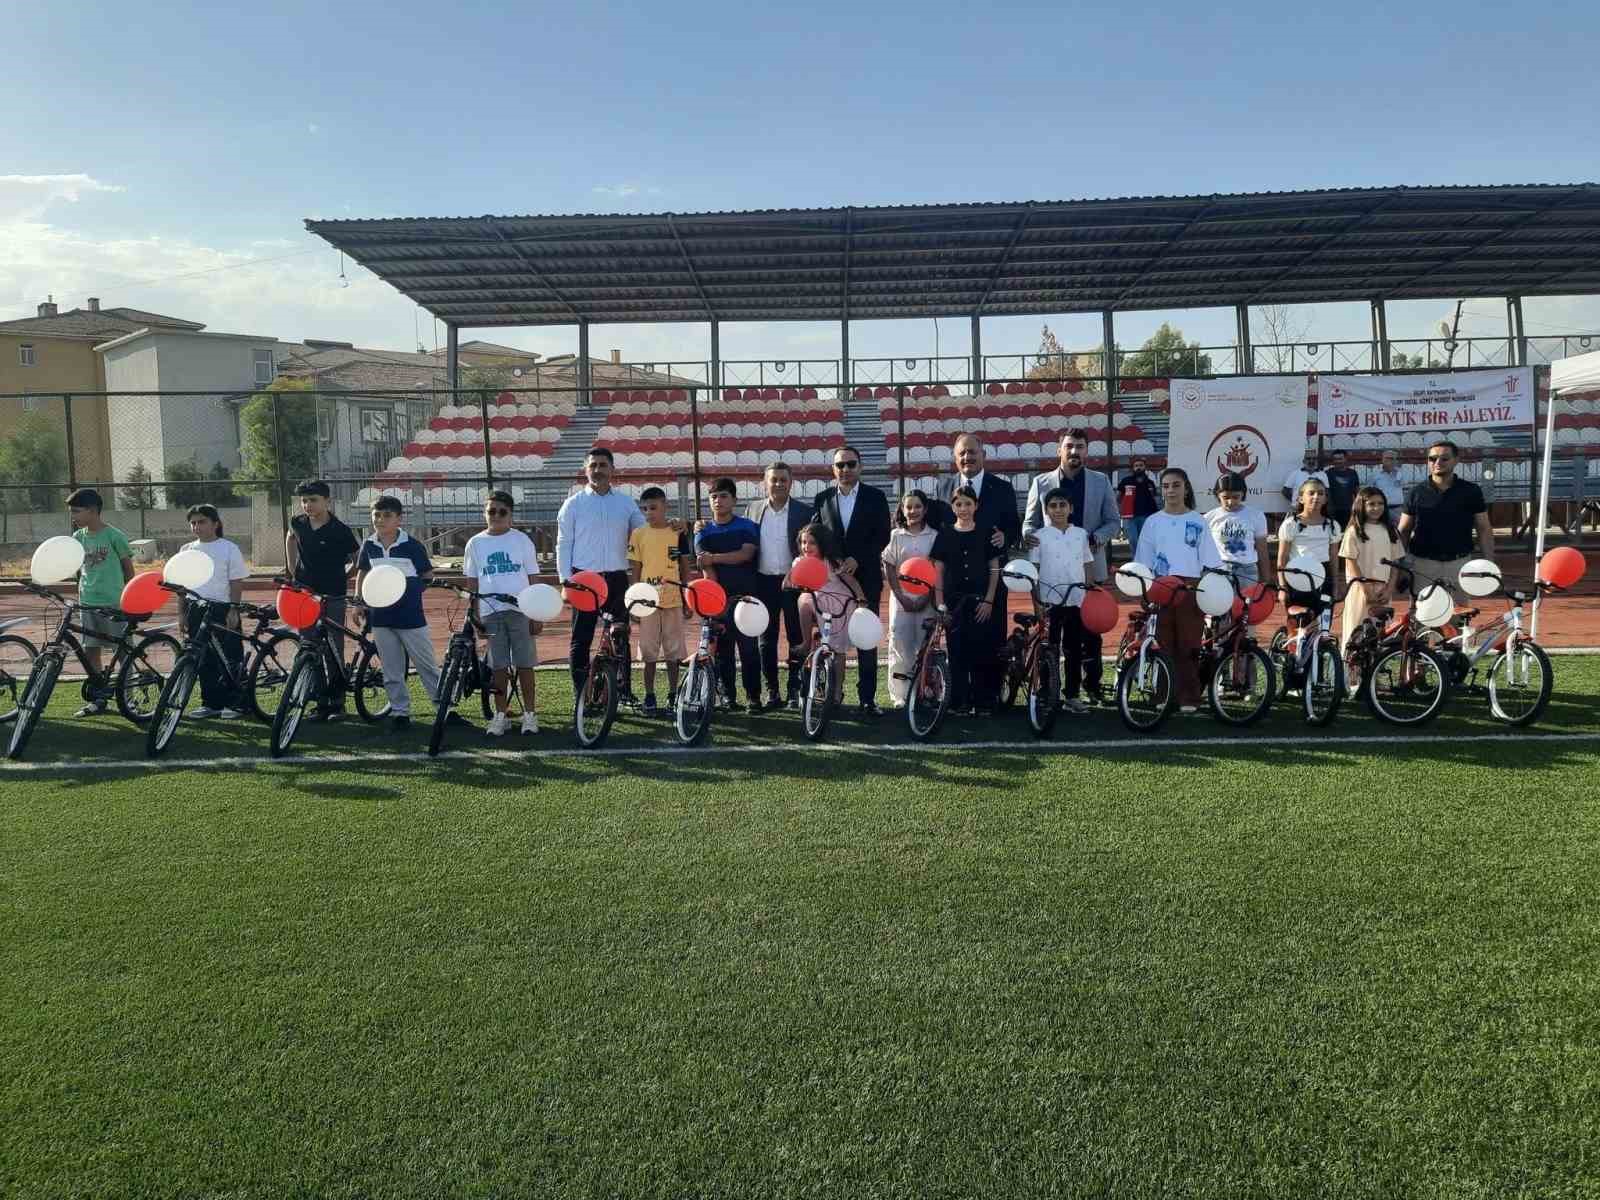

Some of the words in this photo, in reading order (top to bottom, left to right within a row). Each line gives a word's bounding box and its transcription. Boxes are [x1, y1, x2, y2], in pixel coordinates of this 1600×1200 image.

[1334, 409, 1359, 428] BİZ
[1365, 408, 1417, 427] BÜYÜK
[1422, 407, 1449, 425] BİR
[1453, 402, 1516, 424] AİLEYİZ.
